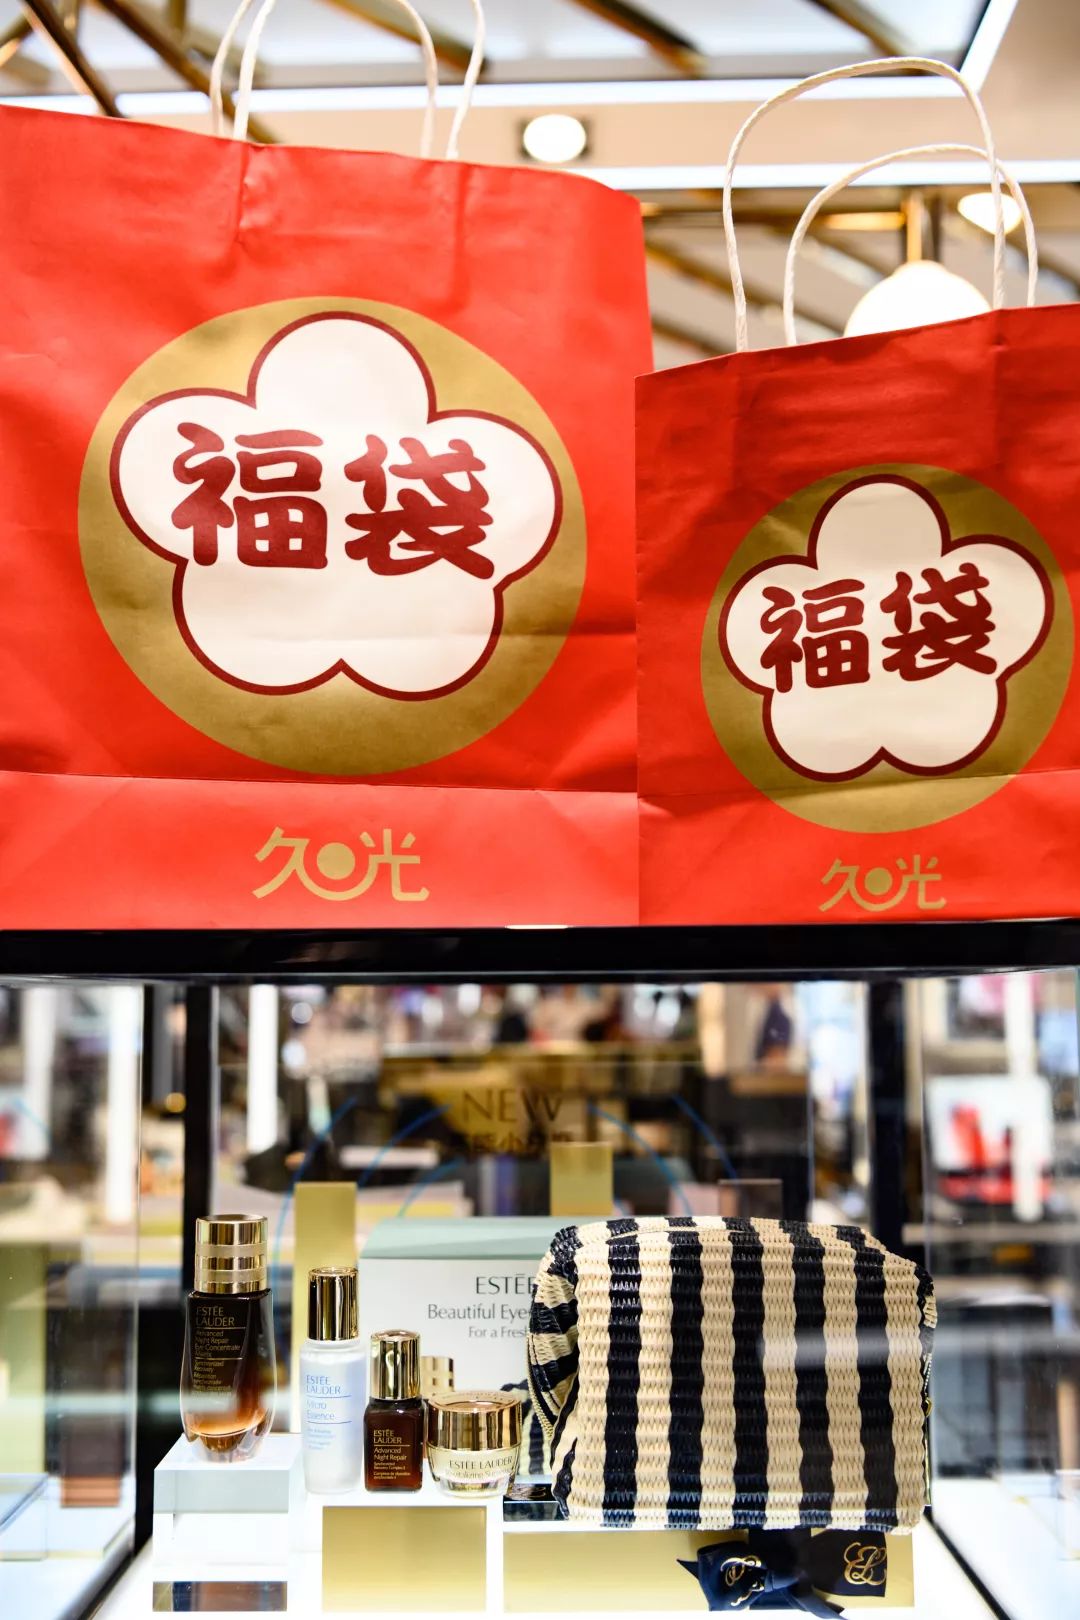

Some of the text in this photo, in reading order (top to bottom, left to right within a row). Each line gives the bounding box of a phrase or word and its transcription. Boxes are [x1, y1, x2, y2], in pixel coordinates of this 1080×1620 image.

[171, 421, 495, 580] 福袋
[759, 562, 998, 693] 福袋
[462, 1088, 562, 1122] NEW
[427, 1303, 531, 1324] Beautiful Eye
[195, 1316, 235, 1327] LAUDER
[468, 1326, 487, 1338] For
[490, 1329, 498, 1338] a
[306, 1385, 341, 1395] LAUDER
[373, 1436, 403, 1444] LAUDER
[373, 1454, 408, 1462] Night Repair
[479, 1455, 513, 1469] LAUDER
